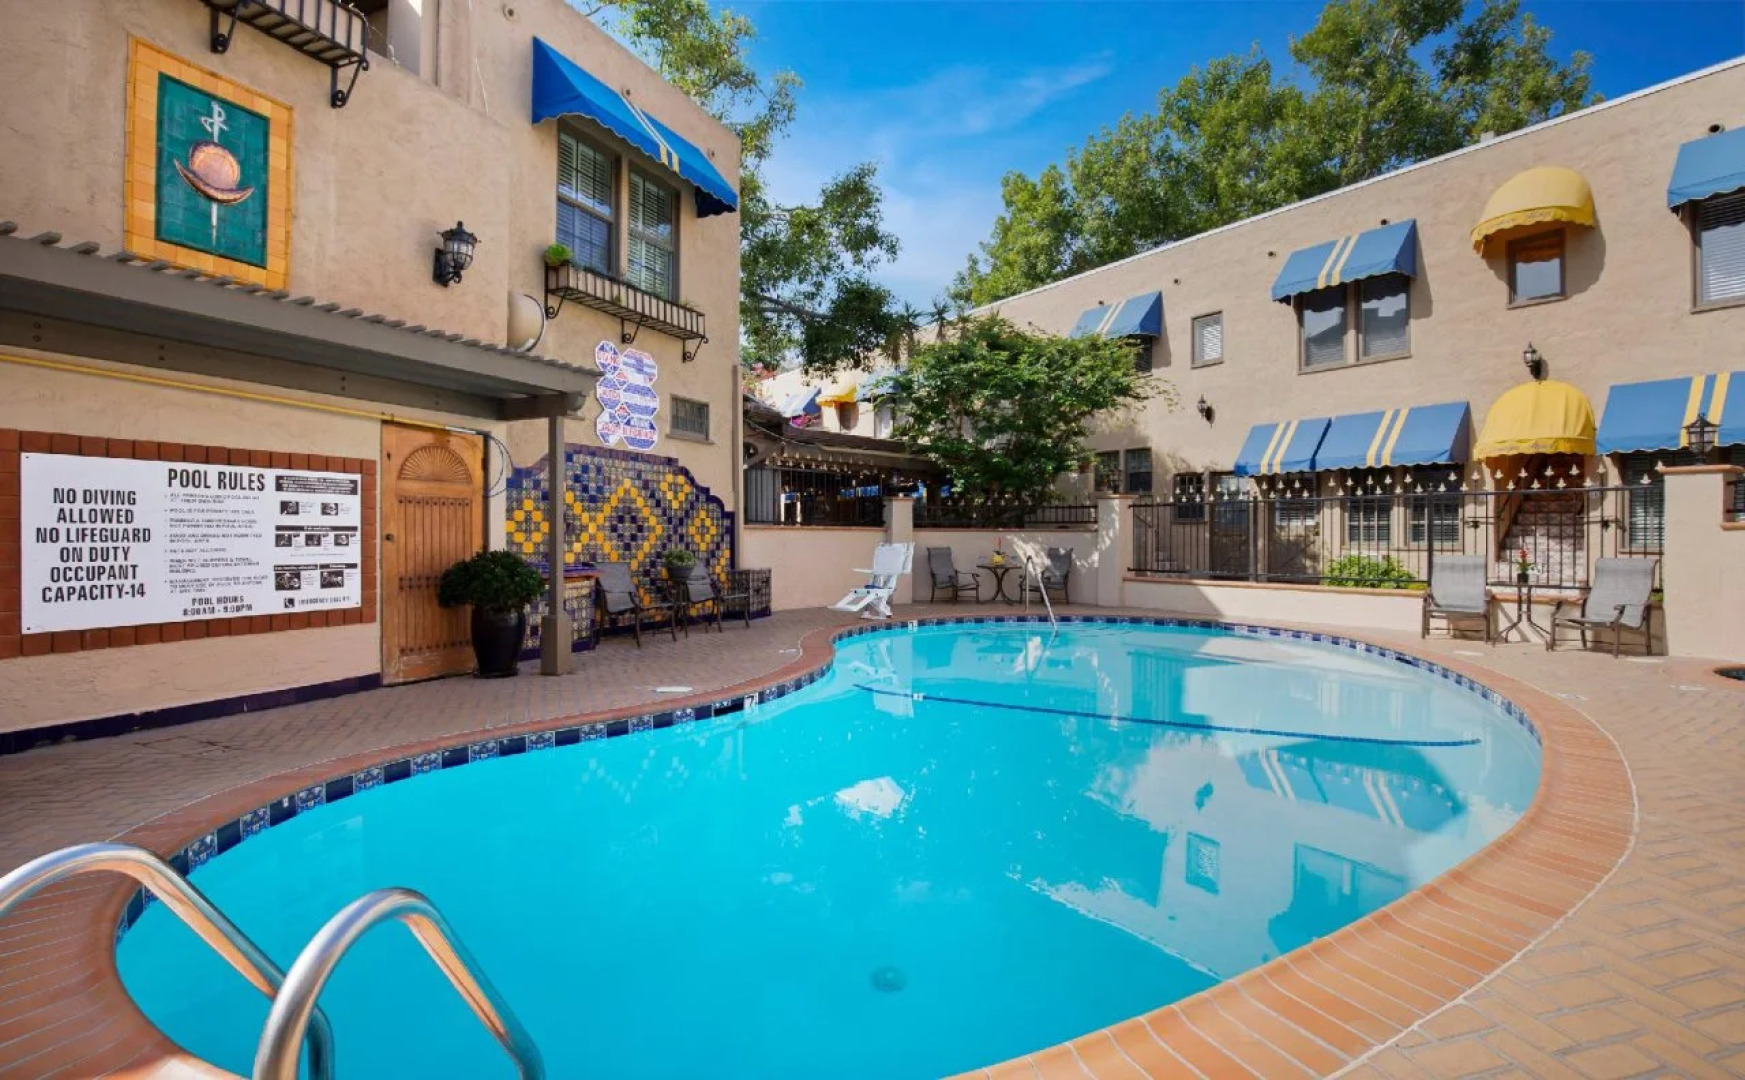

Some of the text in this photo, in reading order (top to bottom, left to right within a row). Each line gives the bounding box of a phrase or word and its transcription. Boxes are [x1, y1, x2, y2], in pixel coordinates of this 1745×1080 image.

[168, 468, 211, 489] POOL
[217, 471, 266, 491] RULES
[53, 487, 137, 505] NO DIVING
[56, 507, 134, 524] ALLOWED
[36, 527, 151, 543] NO LIFEGUARD
[60, 546, 130, 563] ON DUTY
[50, 564, 139, 583] OCCUPANT
[41, 583, 146, 603] CAPACITY-14
[191, 595, 245, 606] POOL HOURS
